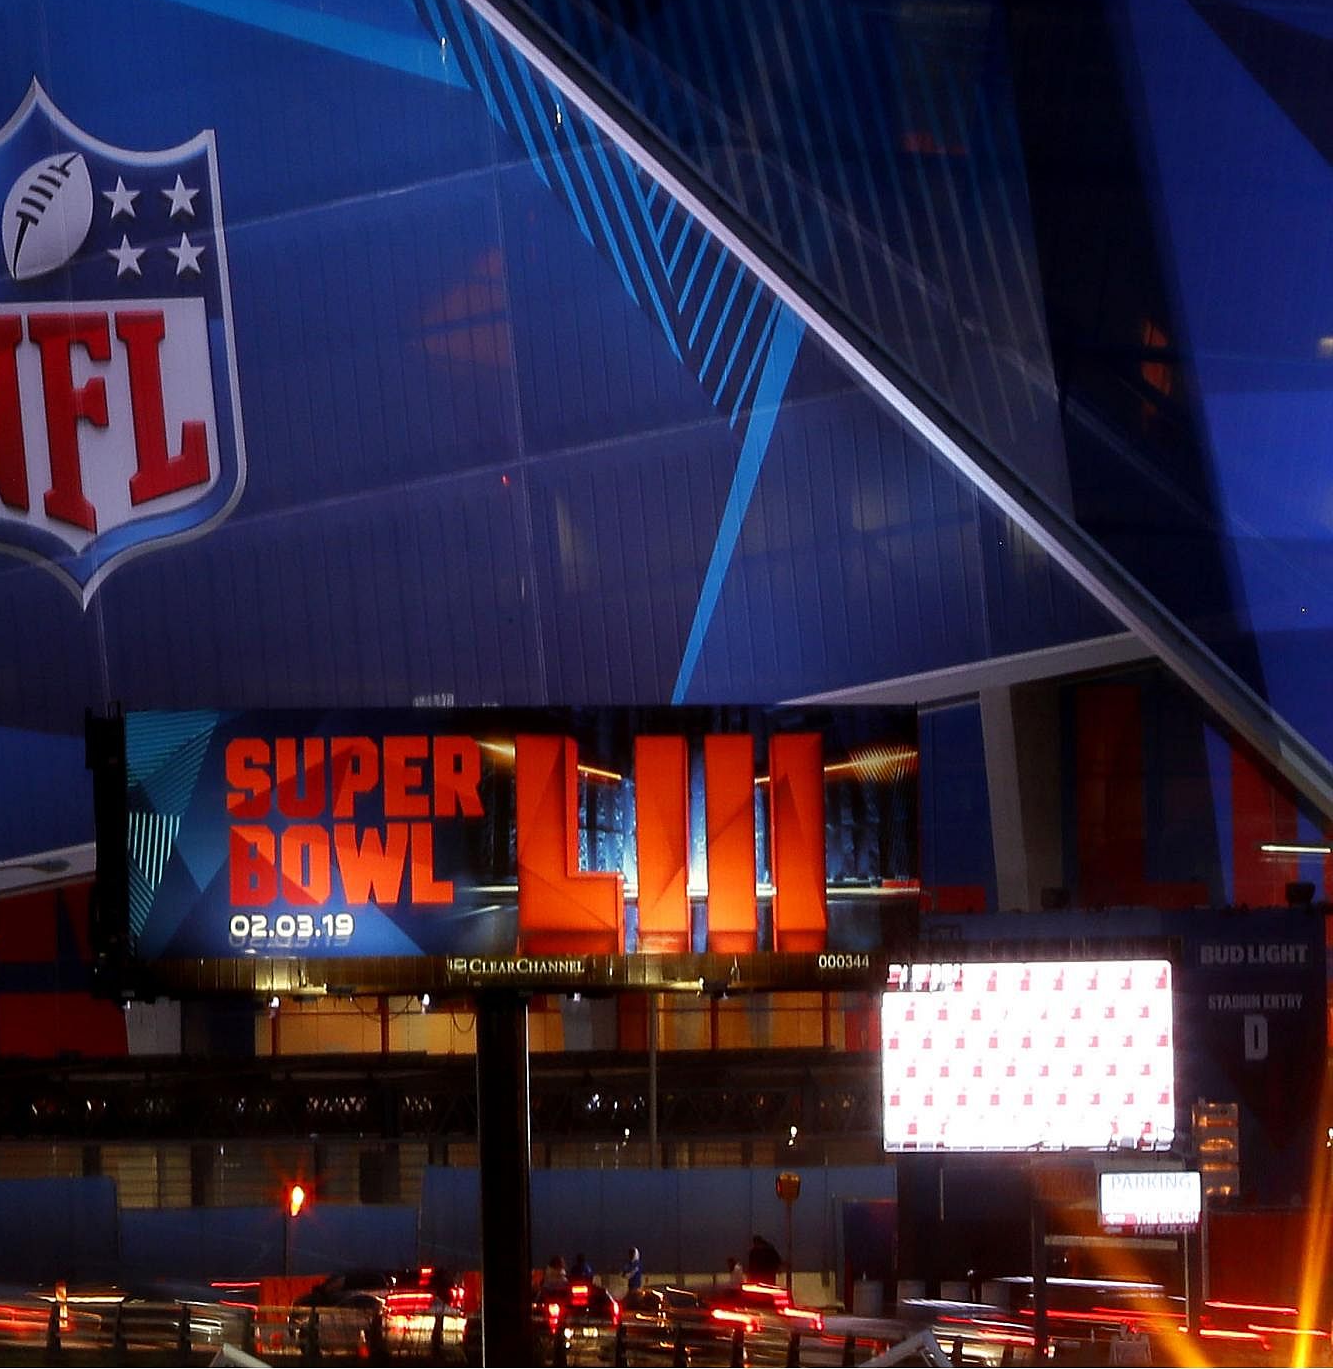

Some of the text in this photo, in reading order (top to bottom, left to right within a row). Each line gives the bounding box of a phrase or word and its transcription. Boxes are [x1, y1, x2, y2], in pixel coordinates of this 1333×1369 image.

[226, 735, 484, 819] SUPER
[516, 734, 828, 954] LIII
[229, 822, 454, 906] BOWL
[230, 914, 354, 939] 02.03.19
[818, 954, 869, 968] 000344
[1200, 943, 1309, 964] BUD LIGHT
[1244, 1014, 1269, 1061] D
[1112, 1175, 1191, 1190] PARKING
